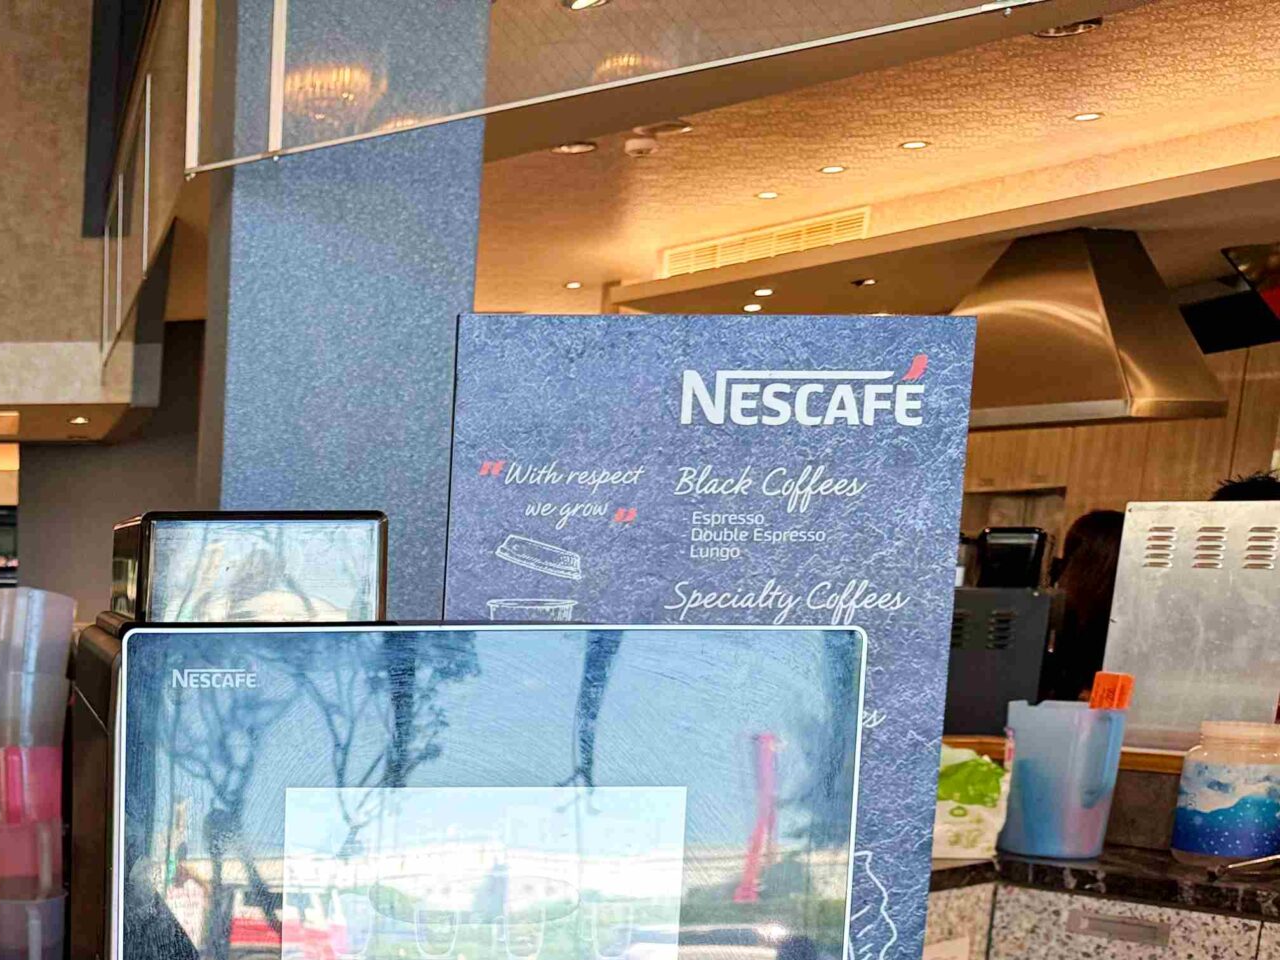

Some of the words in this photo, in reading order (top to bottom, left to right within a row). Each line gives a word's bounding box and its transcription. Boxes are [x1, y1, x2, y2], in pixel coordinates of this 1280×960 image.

[680, 354, 928, 427] NESCAFÉ
[566, 466, 645, 492] respect
[674, 465, 751, 497] Black
[761, 467, 868, 512] Coffees
[525, 502, 558, 518] we
[692, 511, 765, 528] Espresso
[691, 527, 750, 542] Double
[753, 528, 826, 544] Espresso
[689, 546, 741, 560] Lungo
[664, 581, 800, 624] Specialty
[807, 582, 910, 625] Coffees
